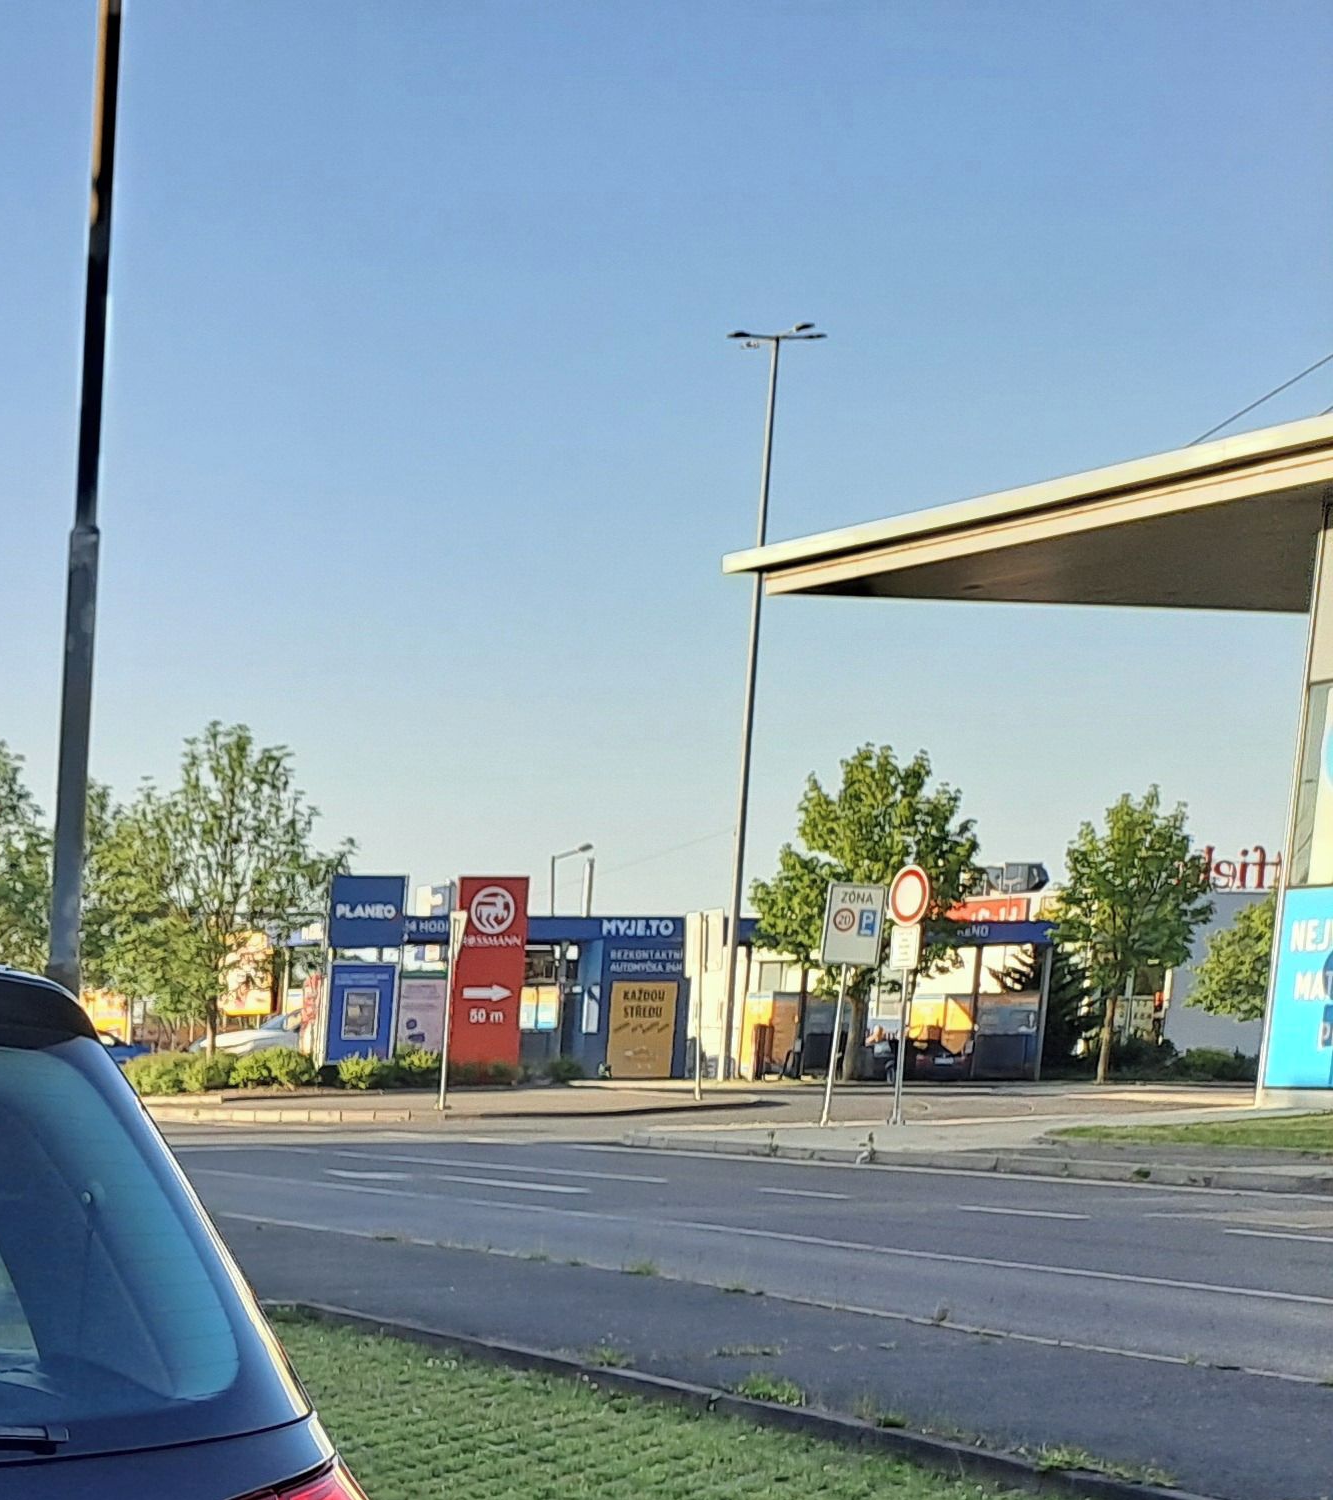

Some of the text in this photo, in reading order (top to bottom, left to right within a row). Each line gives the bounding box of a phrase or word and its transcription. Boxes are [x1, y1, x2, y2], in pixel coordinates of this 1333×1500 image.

[336, 903, 397, 919] PLANEO
[419, 920, 449, 933] HODI
[602, 919, 674, 937] MYJE.TO
[838, 914, 851, 926] 20
[862, 912, 874, 929] P
[1290, 918, 1333, 952] NEJ
[469, 1008, 504, 1024] 50 m
